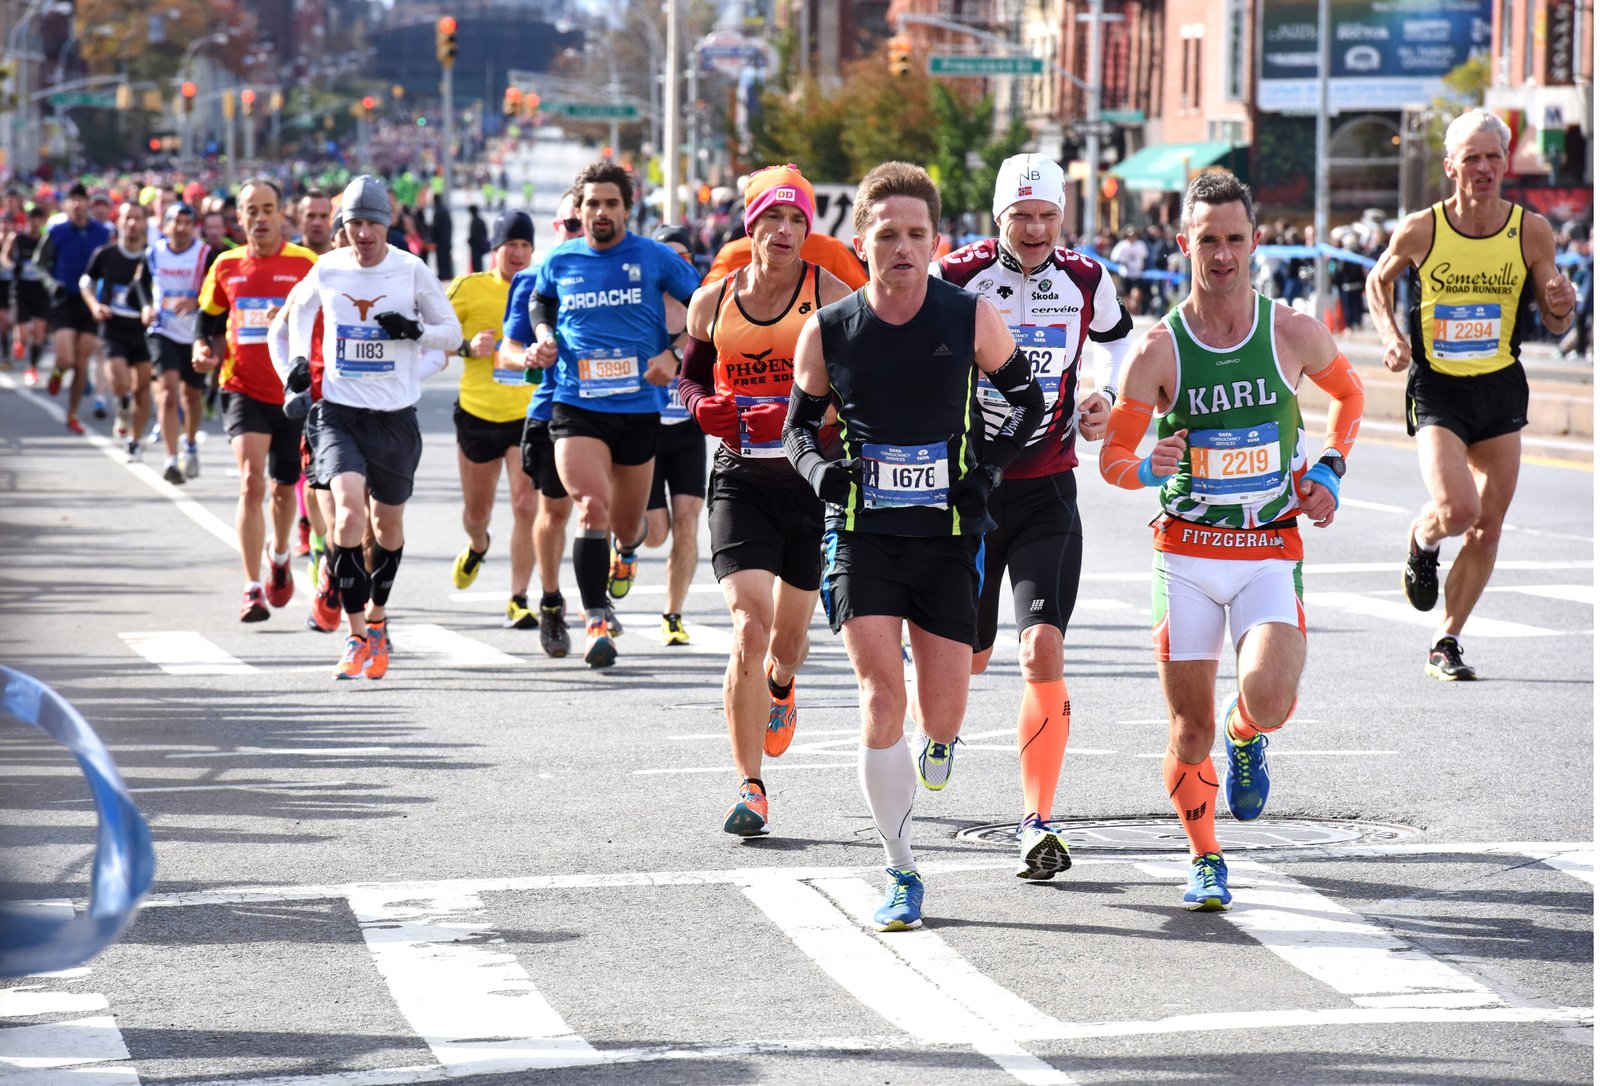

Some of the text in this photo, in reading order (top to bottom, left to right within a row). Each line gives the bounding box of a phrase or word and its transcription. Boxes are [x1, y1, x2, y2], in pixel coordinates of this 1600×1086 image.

[1430, 262, 1519, 293] Somerville
[562, 288, 642, 310] JORDACHE
[1031, 291, 1059, 301] Škoda
[1446, 285, 1513, 294] ROAD RUNNERS
[1031, 304, 1079, 313] cervélo
[1454, 321, 1493, 340] 2294
[356, 342, 384, 359] 1183
[596, 360, 631, 378] 5890
[725, 358, 794, 378] PHOEN
[1024, 350, 1053, 374] 62
[733, 373, 794, 386] FREE SO
[1187, 377, 1277, 416] KARL
[880, 450, 911, 458] CONSULTANCY
[1222, 448, 1269, 476] 2219
[868, 474, 876, 487] A
[892, 466, 935, 488] 1678
[1181, 528, 1285, 547] FITZGERA
